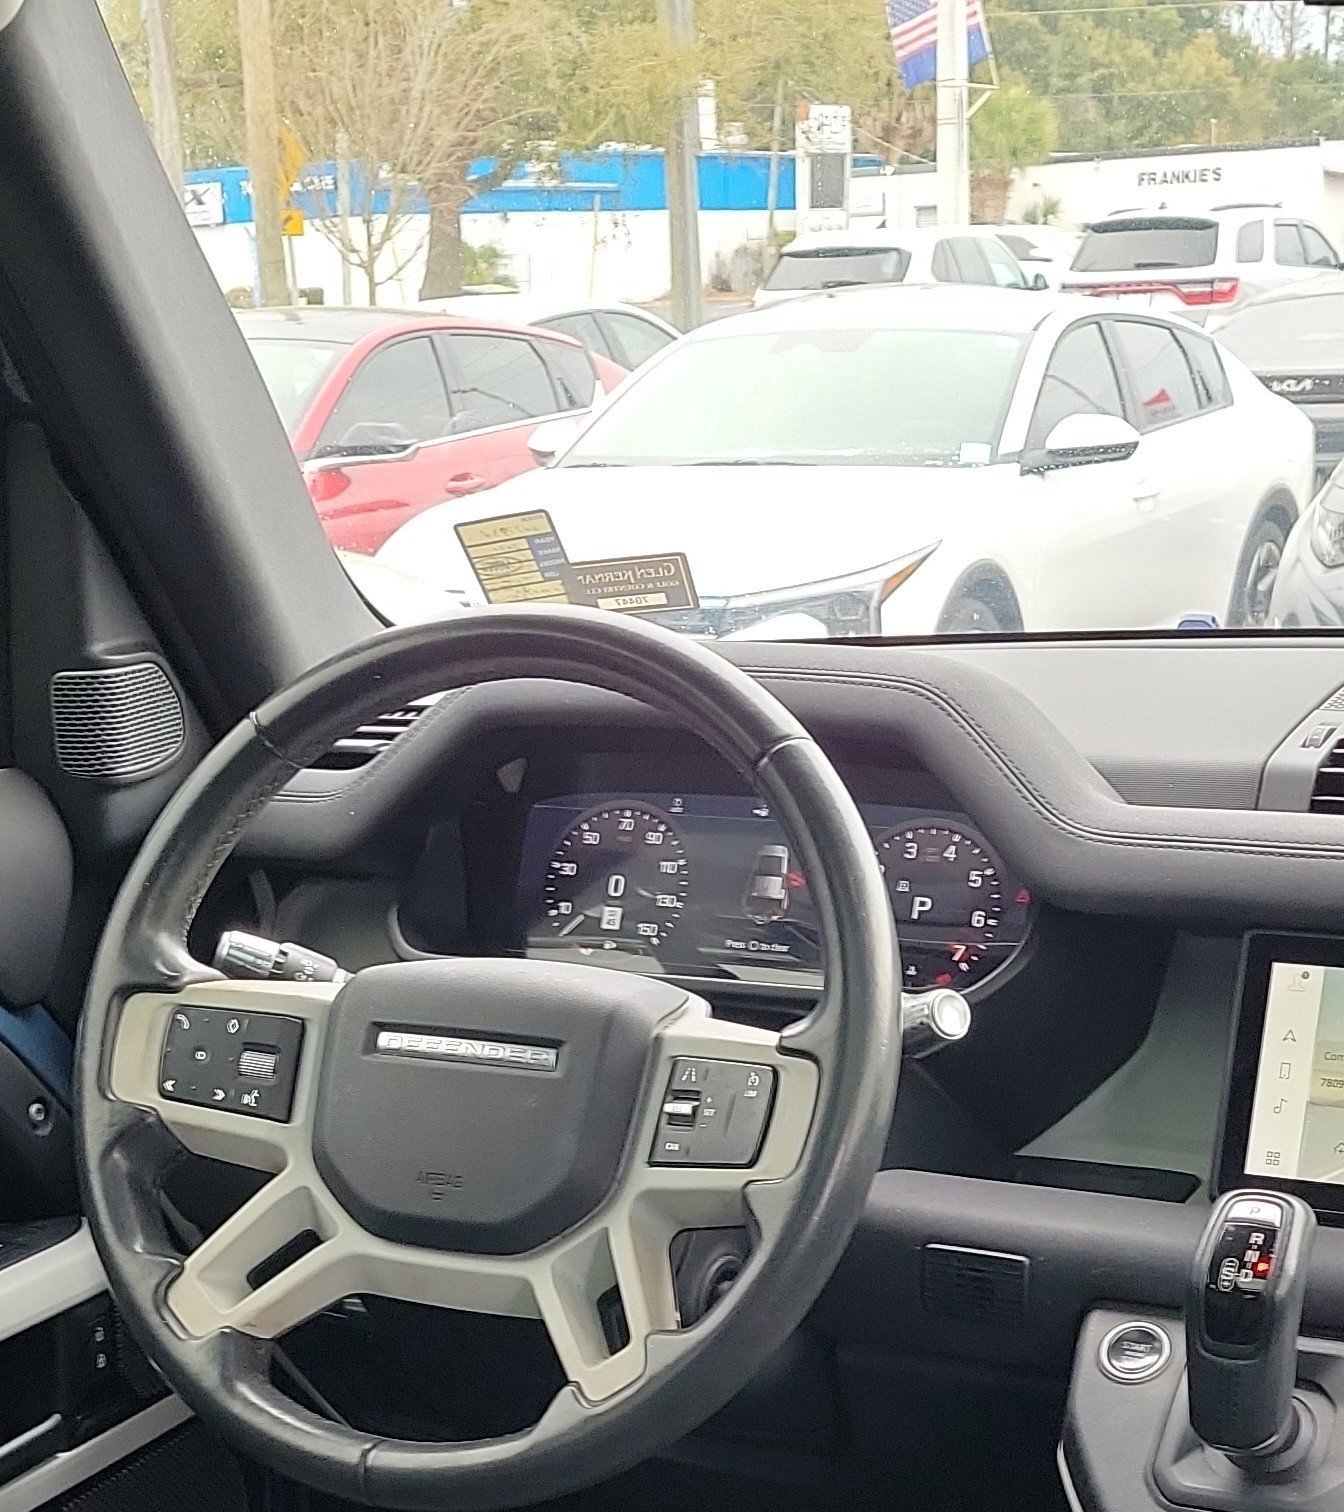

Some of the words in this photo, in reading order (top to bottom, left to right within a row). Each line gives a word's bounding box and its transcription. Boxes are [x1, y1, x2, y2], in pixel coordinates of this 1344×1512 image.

[618, 817, 635, 831] 70
[581, 831, 600, 845] 50
[644, 831, 664, 845] 90
[903, 842, 918, 859] 3
[942, 845, 957, 862] 4
[558, 862, 578, 876] 30
[607, 874, 626, 897] 0
[967, 870, 983, 888] 5
[910, 896, 933, 920] P
[971, 910, 987, 928] 6
[951, 944, 967, 961] 7
[386, 1034, 553, 1065] DEFENDER
[1249, 1206, 1261, 1215] P
[1248, 1232, 1265, 1245] R
[1243, 1250, 1261, 1262] N
[1240, 1269, 1254, 1281] D
